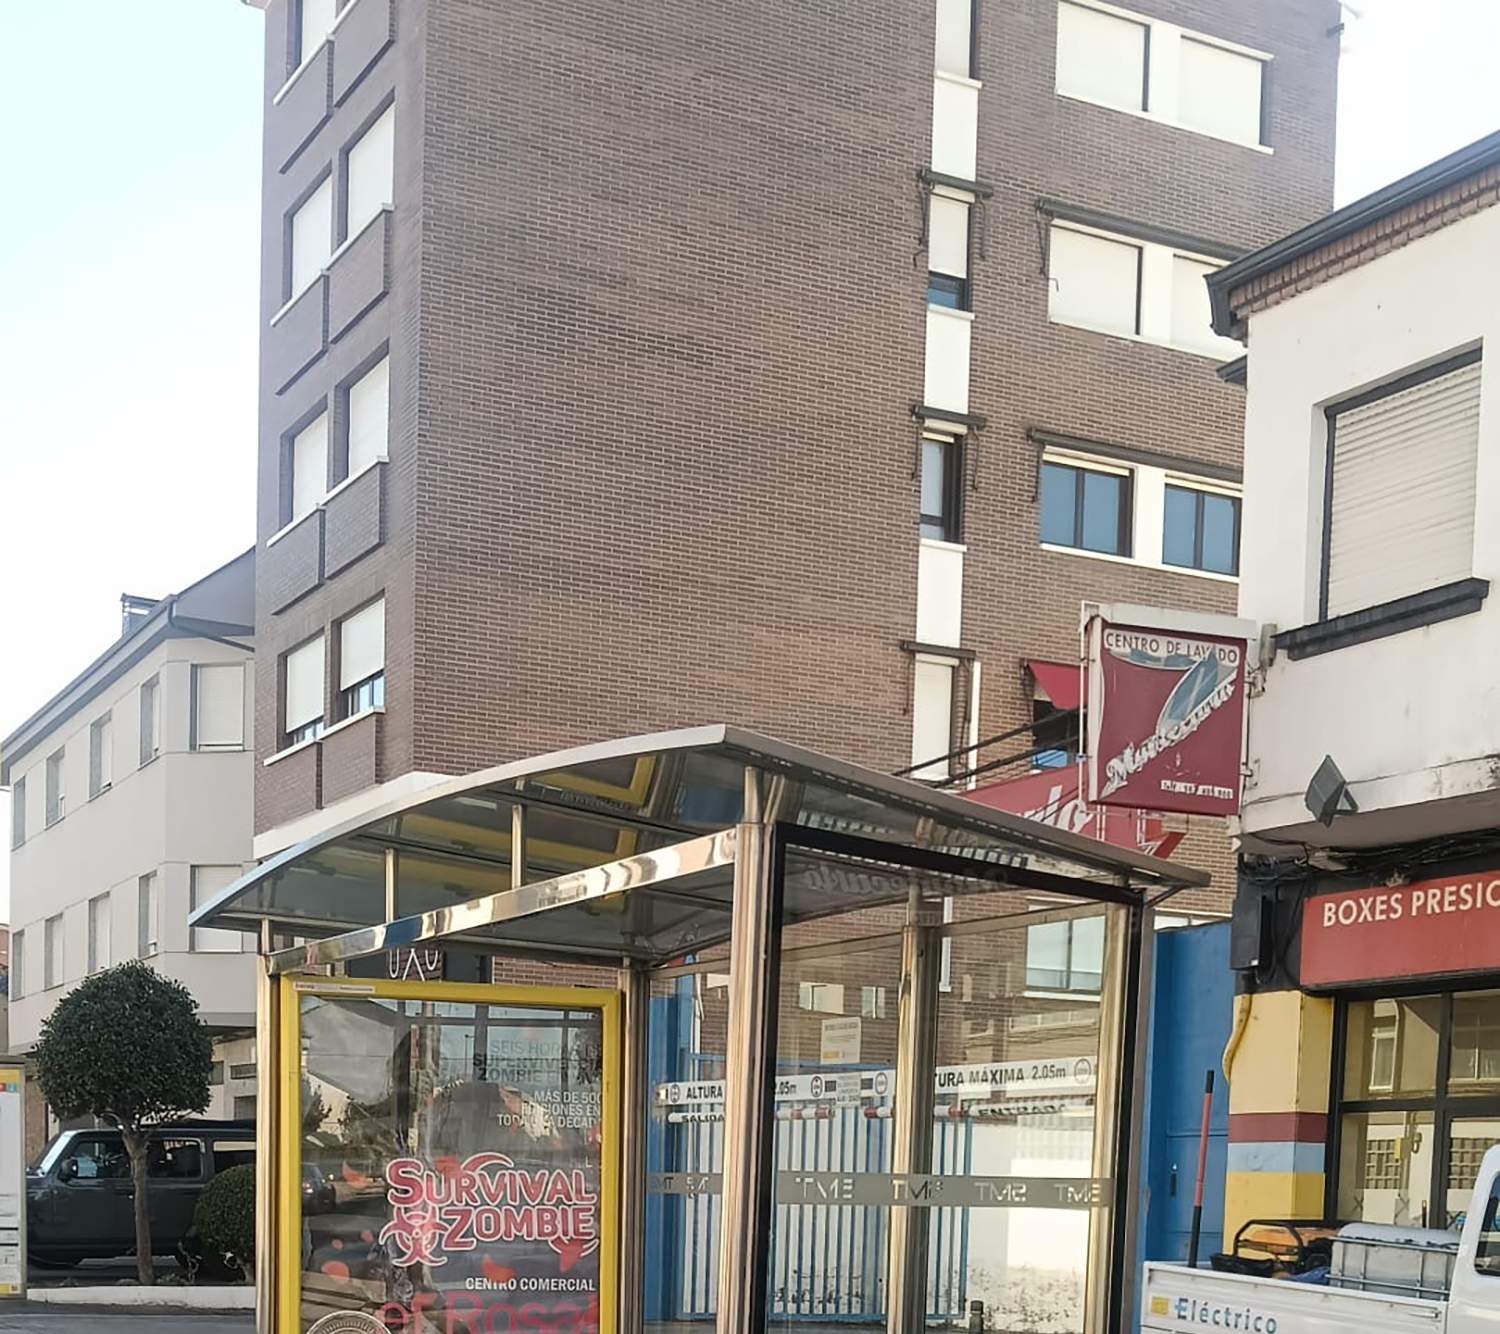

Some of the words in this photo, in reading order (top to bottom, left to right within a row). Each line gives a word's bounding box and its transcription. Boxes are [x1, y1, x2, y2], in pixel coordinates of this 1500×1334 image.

[1106, 632, 1160, 653] CENTRO
[1166, 640, 1181, 655] DE
[1323, 893, 1402, 928] BOXES
[968, 1066, 1025, 1085] MÁXIMA
[1031, 1065, 1067, 1080] 2.05m
[534, 1088, 560, 1103] MÁS
[563, 1091, 579, 1104] DE
[686, 1085, 723, 1100] ALTURA
[681, 1114, 725, 1123] SALIDA
[387, 1157, 597, 1207] SURVIVAL
[442, 1205, 596, 1250] ZOMBIE
[465, 1277, 517, 1292] CENTRO
[520, 1277, 597, 1292] COMERCIAL
[1176, 1297, 1277, 1334] Eléctrico
